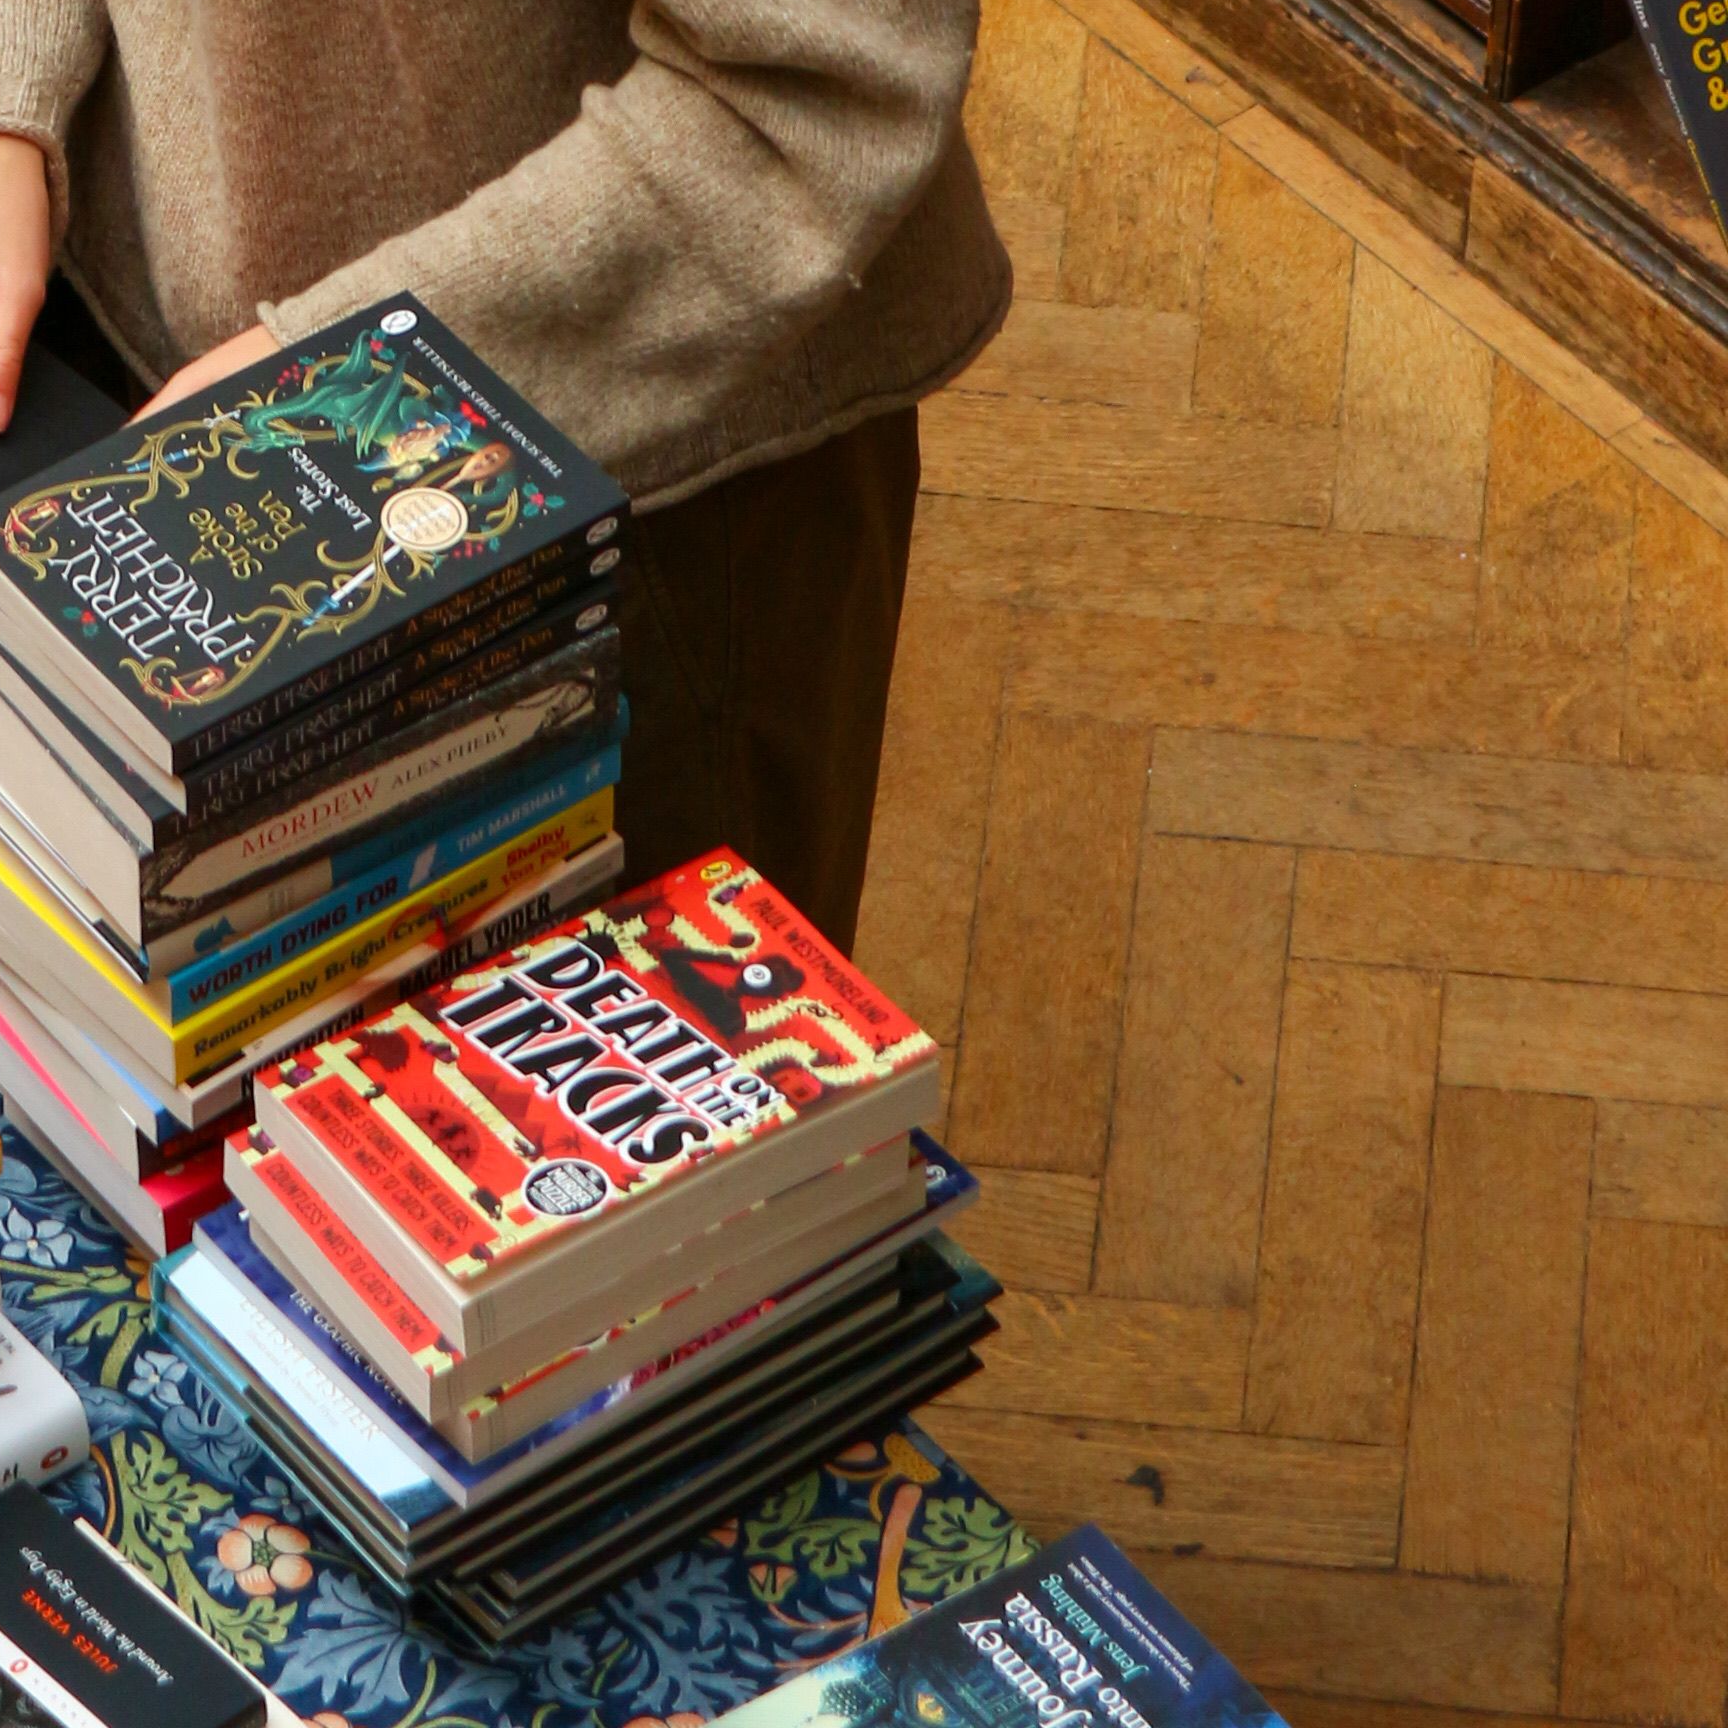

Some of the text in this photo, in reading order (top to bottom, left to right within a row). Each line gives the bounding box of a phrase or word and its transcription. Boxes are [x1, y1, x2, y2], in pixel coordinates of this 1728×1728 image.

[225, 503, 279, 555] of the
[258, 492, 307, 541] Pen
[289, 447, 373, 532] Lost Stories
[296, 485, 325, 513] The
[66, 493, 255, 663] PRATCHETT
[189, 509, 264, 580] Stroke
[190, 545, 214, 565] A
[48, 546, 177, 660] TERRY
[240, 723, 511, 859] MORDEW ALEX PHEBY
[189, 877, 397, 1003] WORTH DYING FOR
[193, 878, 490, 1055] Remarkably Bright Creatures
[750, 899, 889, 1026] PAUL WESTMORELAND
[519, 937, 735, 1098] DEATH
[441, 973, 712, 1164] TRACKS
[696, 1084, 751, 1130] THE
[726, 1073, 785, 1124] ON
[21, 1588, 71, 1635] VERNE
[75, 1634, 118, 1674] JULES
[1005, 1593, 1103, 1697] Russia
